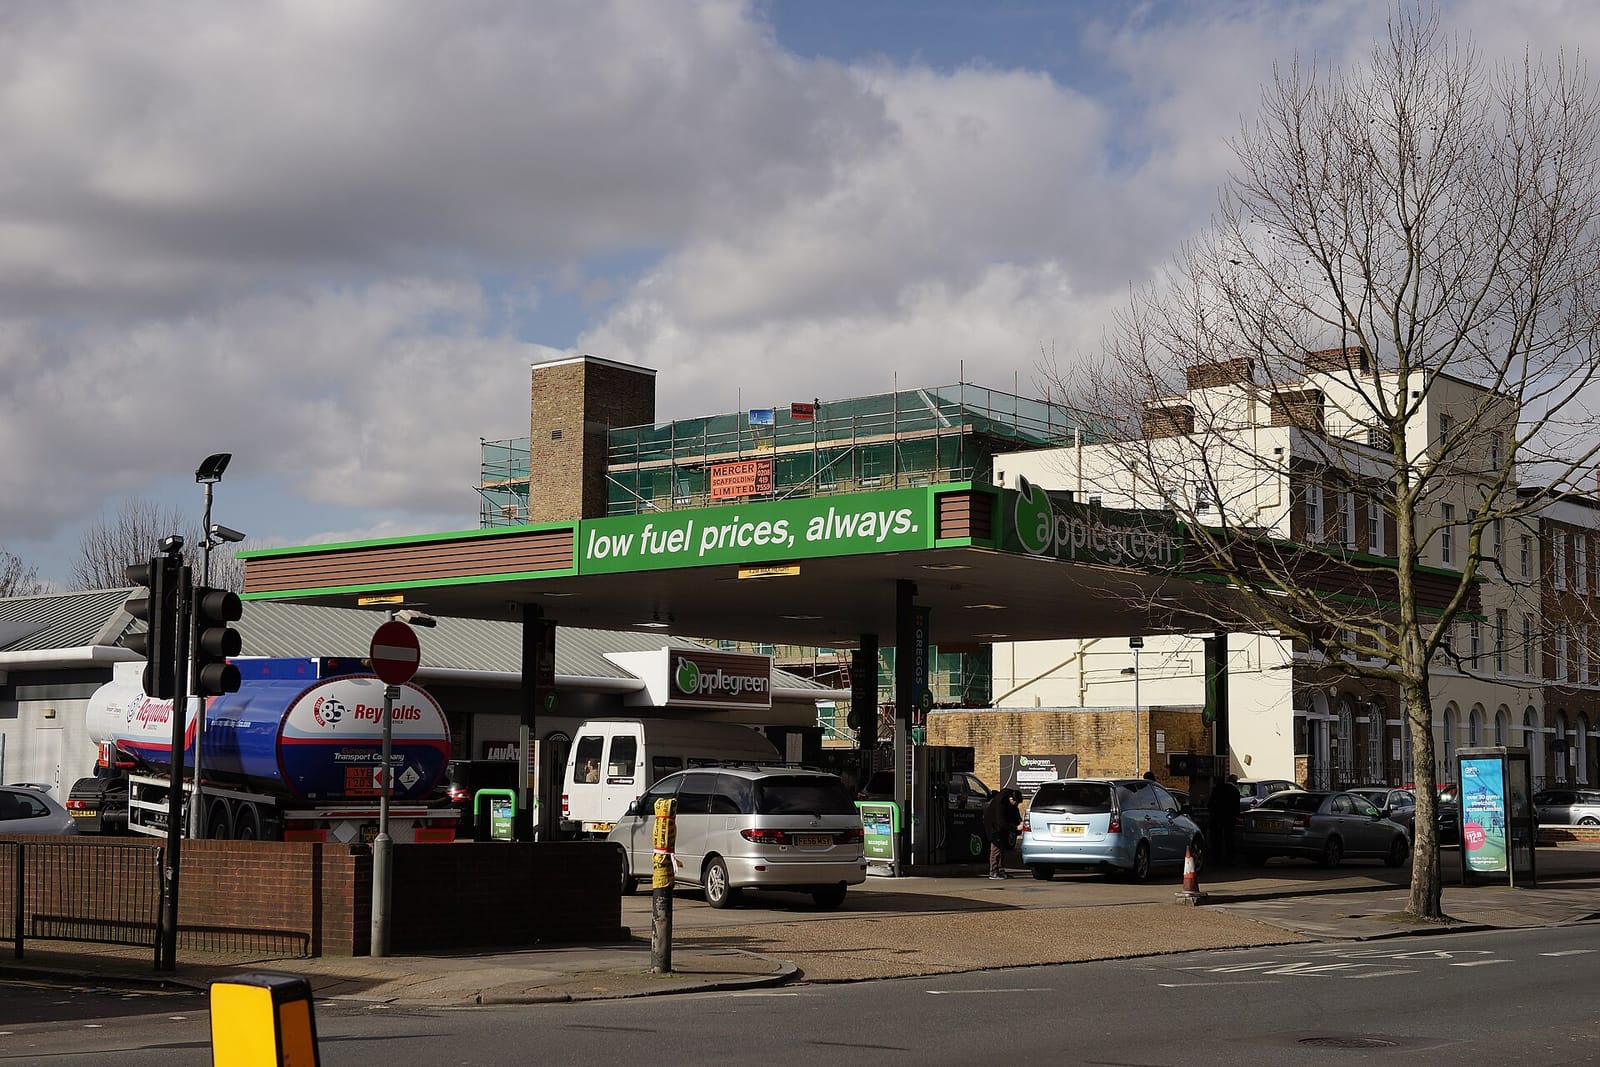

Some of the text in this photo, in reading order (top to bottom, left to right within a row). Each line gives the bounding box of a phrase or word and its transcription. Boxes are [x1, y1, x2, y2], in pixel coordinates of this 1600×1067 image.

[713, 464, 754, 477] MERCER
[713, 476, 754, 486] SCAFFOLDING
[713, 485, 754, 496] LIMITED
[586, 507, 919, 559] low fuel prices, always.
[1036, 511, 1171, 565] applegreen
[915, 628, 923, 685] GREGGS
[689, 668, 769, 696] applegreen
[547, 695, 555, 708] 7
[922, 694, 930, 708] 5
[325, 703, 344, 720] 85
[354, 704, 421, 724] Reyolds
[334, 752, 371, 761] Transport
